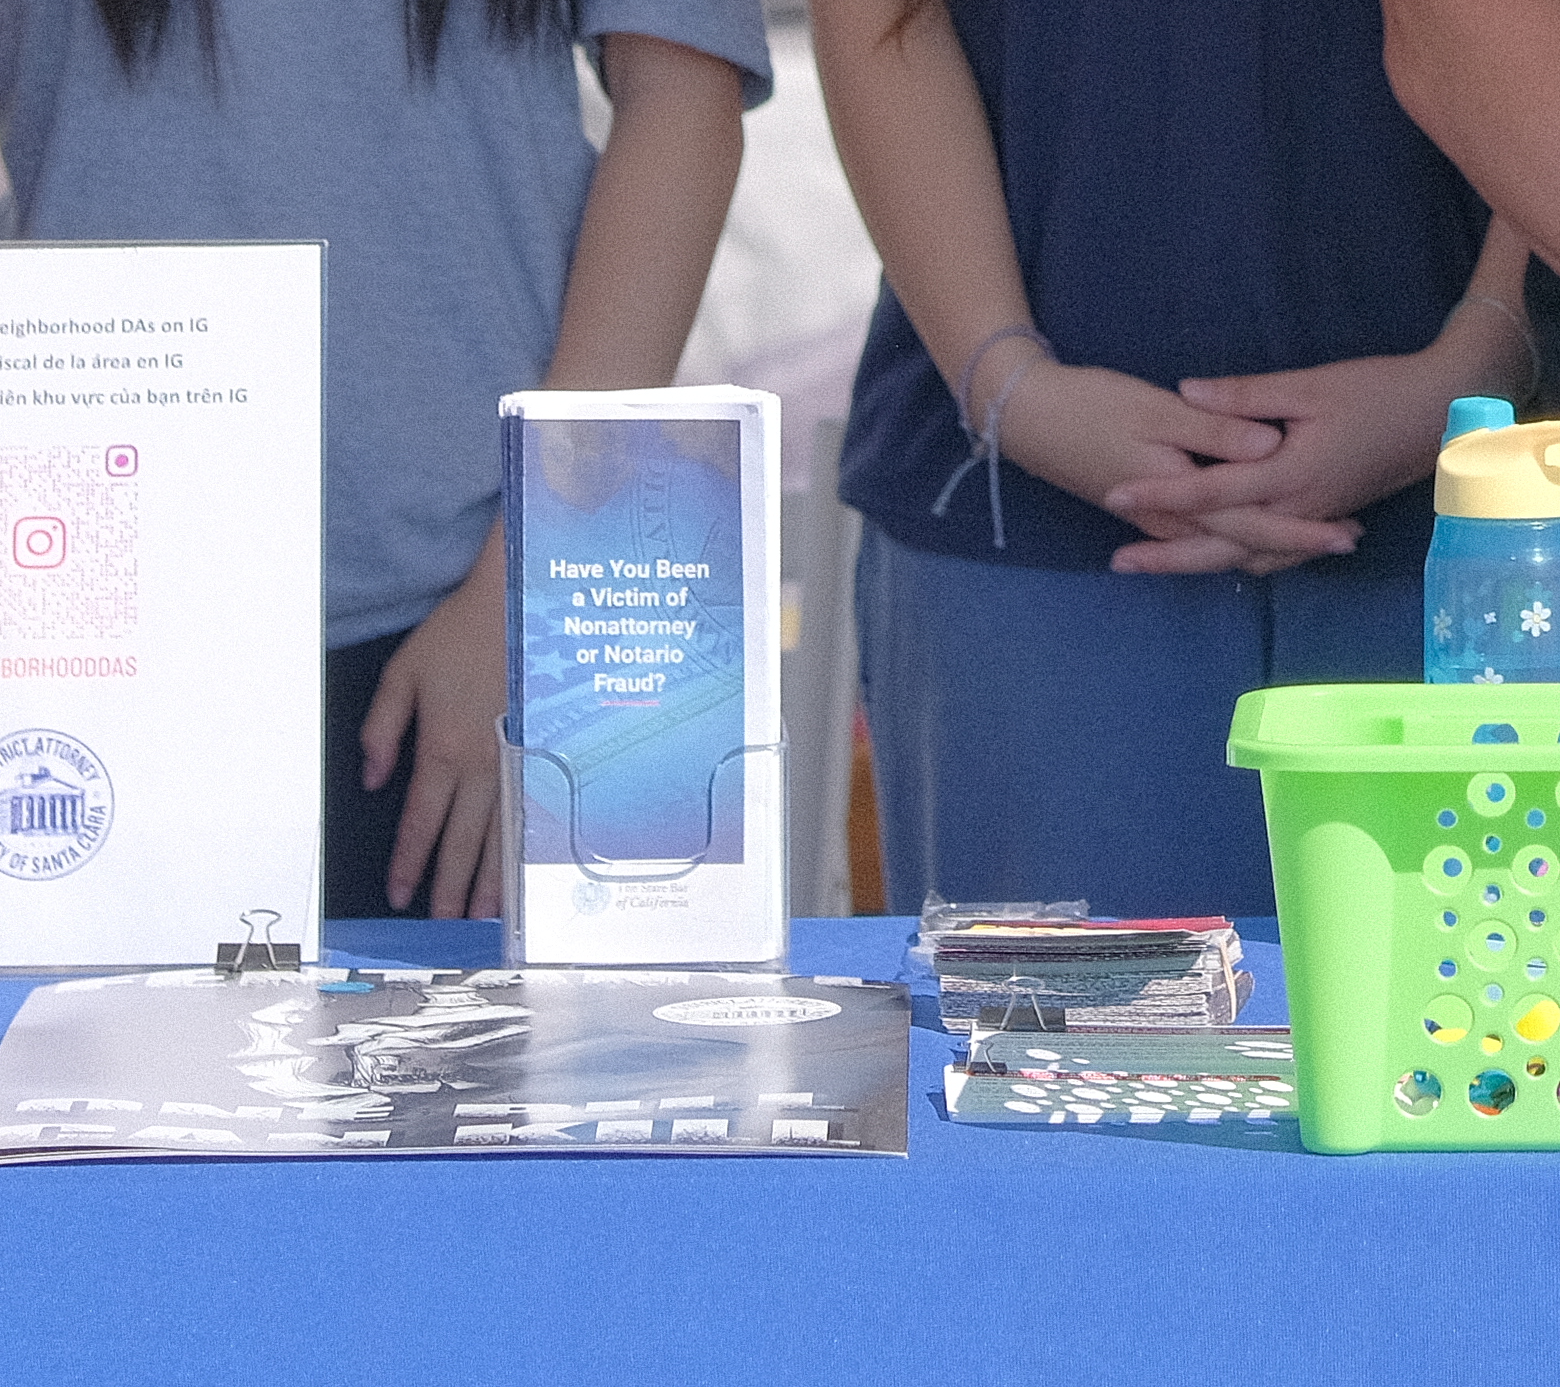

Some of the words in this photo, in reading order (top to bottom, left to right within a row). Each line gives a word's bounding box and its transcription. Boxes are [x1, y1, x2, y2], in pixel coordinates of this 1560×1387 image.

[121, 319, 156, 335] DAs
[161, 321, 184, 334] on
[190, 318, 209, 333] IG
[71, 354, 87, 370] la
[165, 353, 184, 369] IG
[32, 388, 66, 406] khu
[229, 388, 248, 404] IG
[549, 559, 606, 578] Have
[610, 559, 652, 579] You
[657, 559, 710, 578] Been
[571, 592, 584, 607] a
[591, 587, 661, 607] Victim
[666, 586, 689, 607] of
[563, 616, 696, 640] Nonattorney
[576, 648, 599, 664] or
[604, 644, 684, 664] Notario
[593, 672, 666, 693] Fraud?
[31, 845, 82, 874] SANTA
